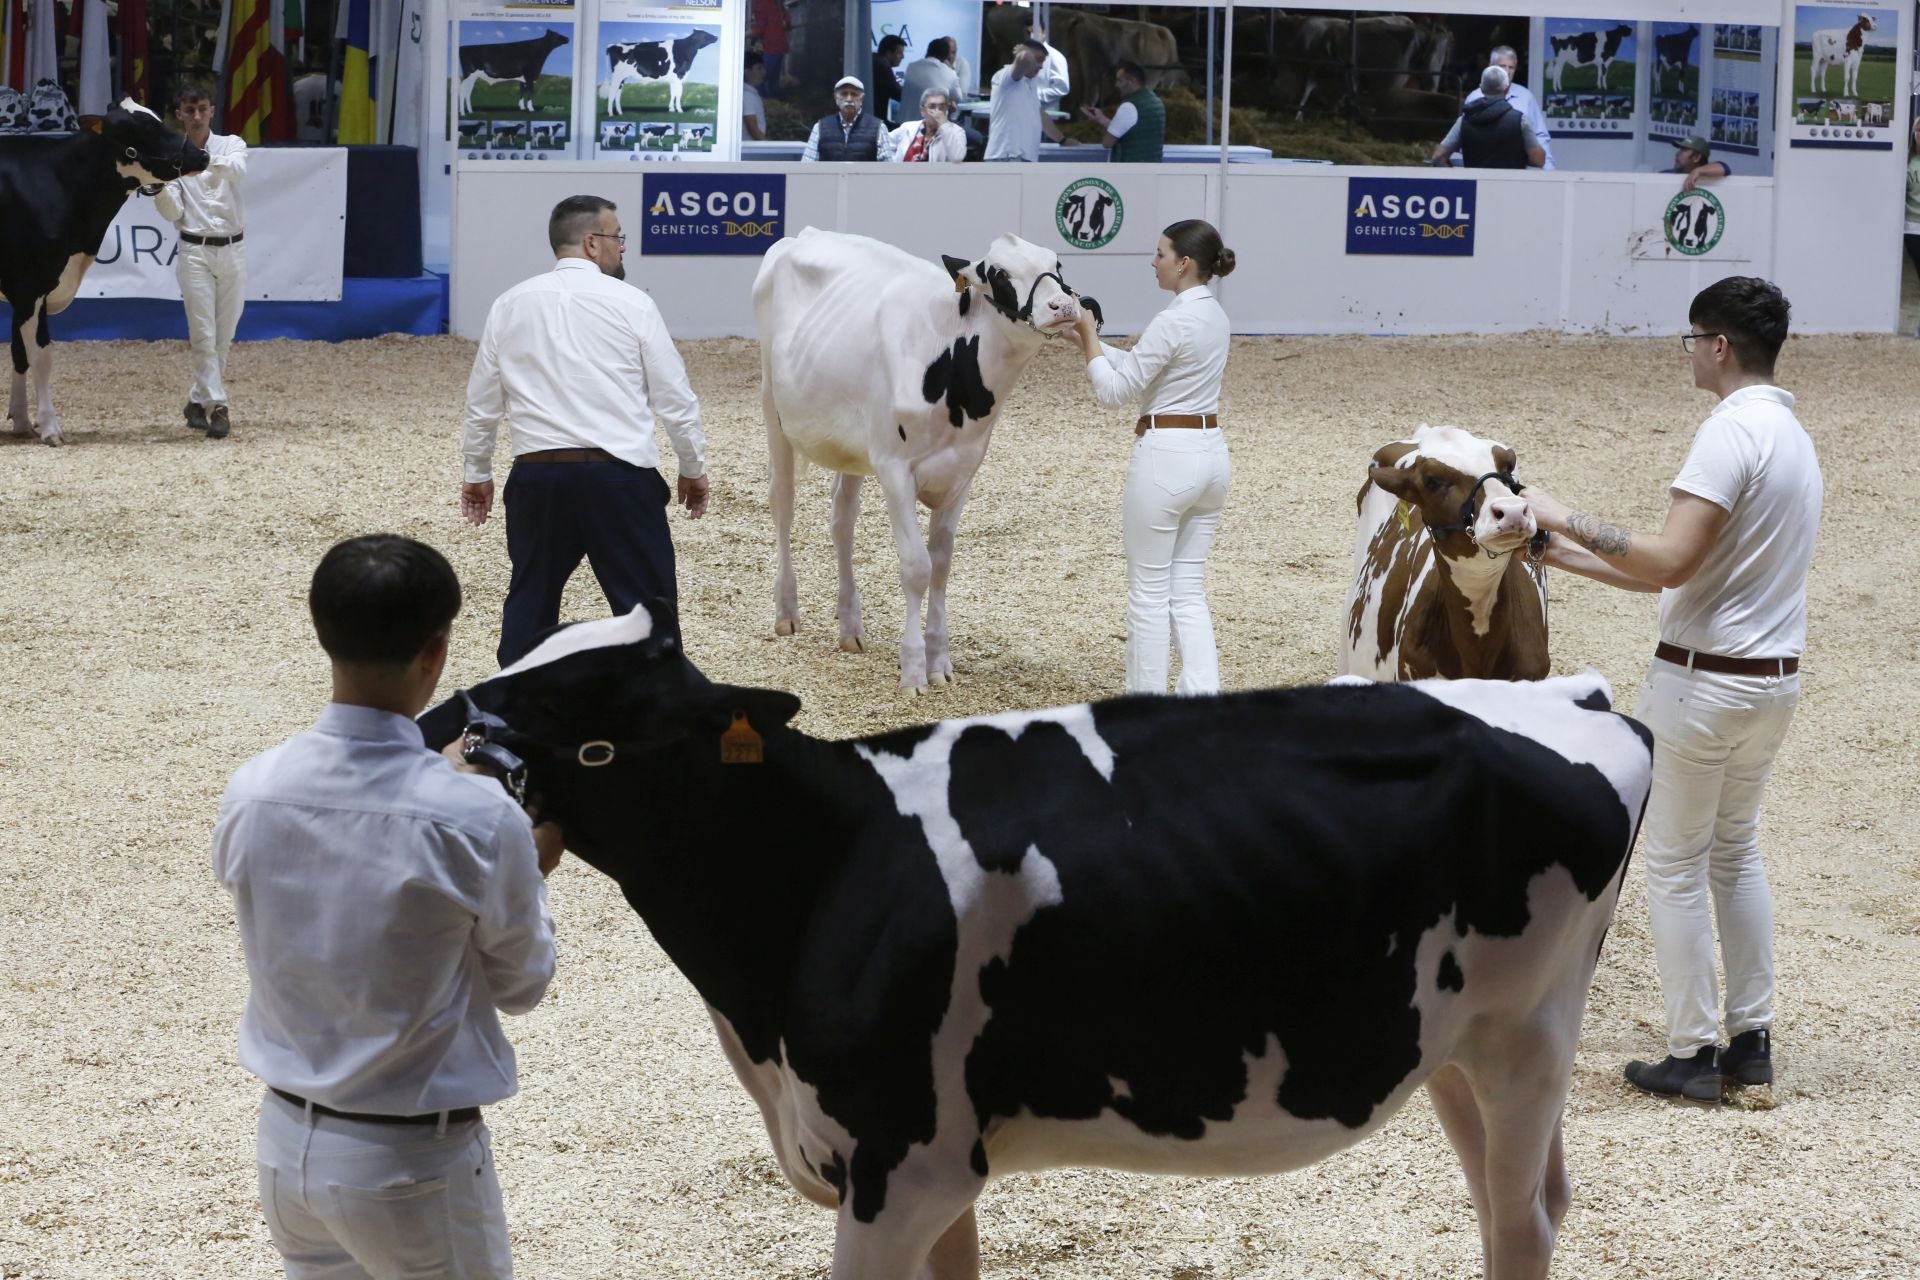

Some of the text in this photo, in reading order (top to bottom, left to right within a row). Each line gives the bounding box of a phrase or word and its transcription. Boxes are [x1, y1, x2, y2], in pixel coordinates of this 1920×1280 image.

[649, 191, 778, 216] ASCOL
[1354, 194, 1470, 219] ASCOL
[650, 224, 719, 235] GENETICS
[1354, 225, 1416, 236] GENETICS
